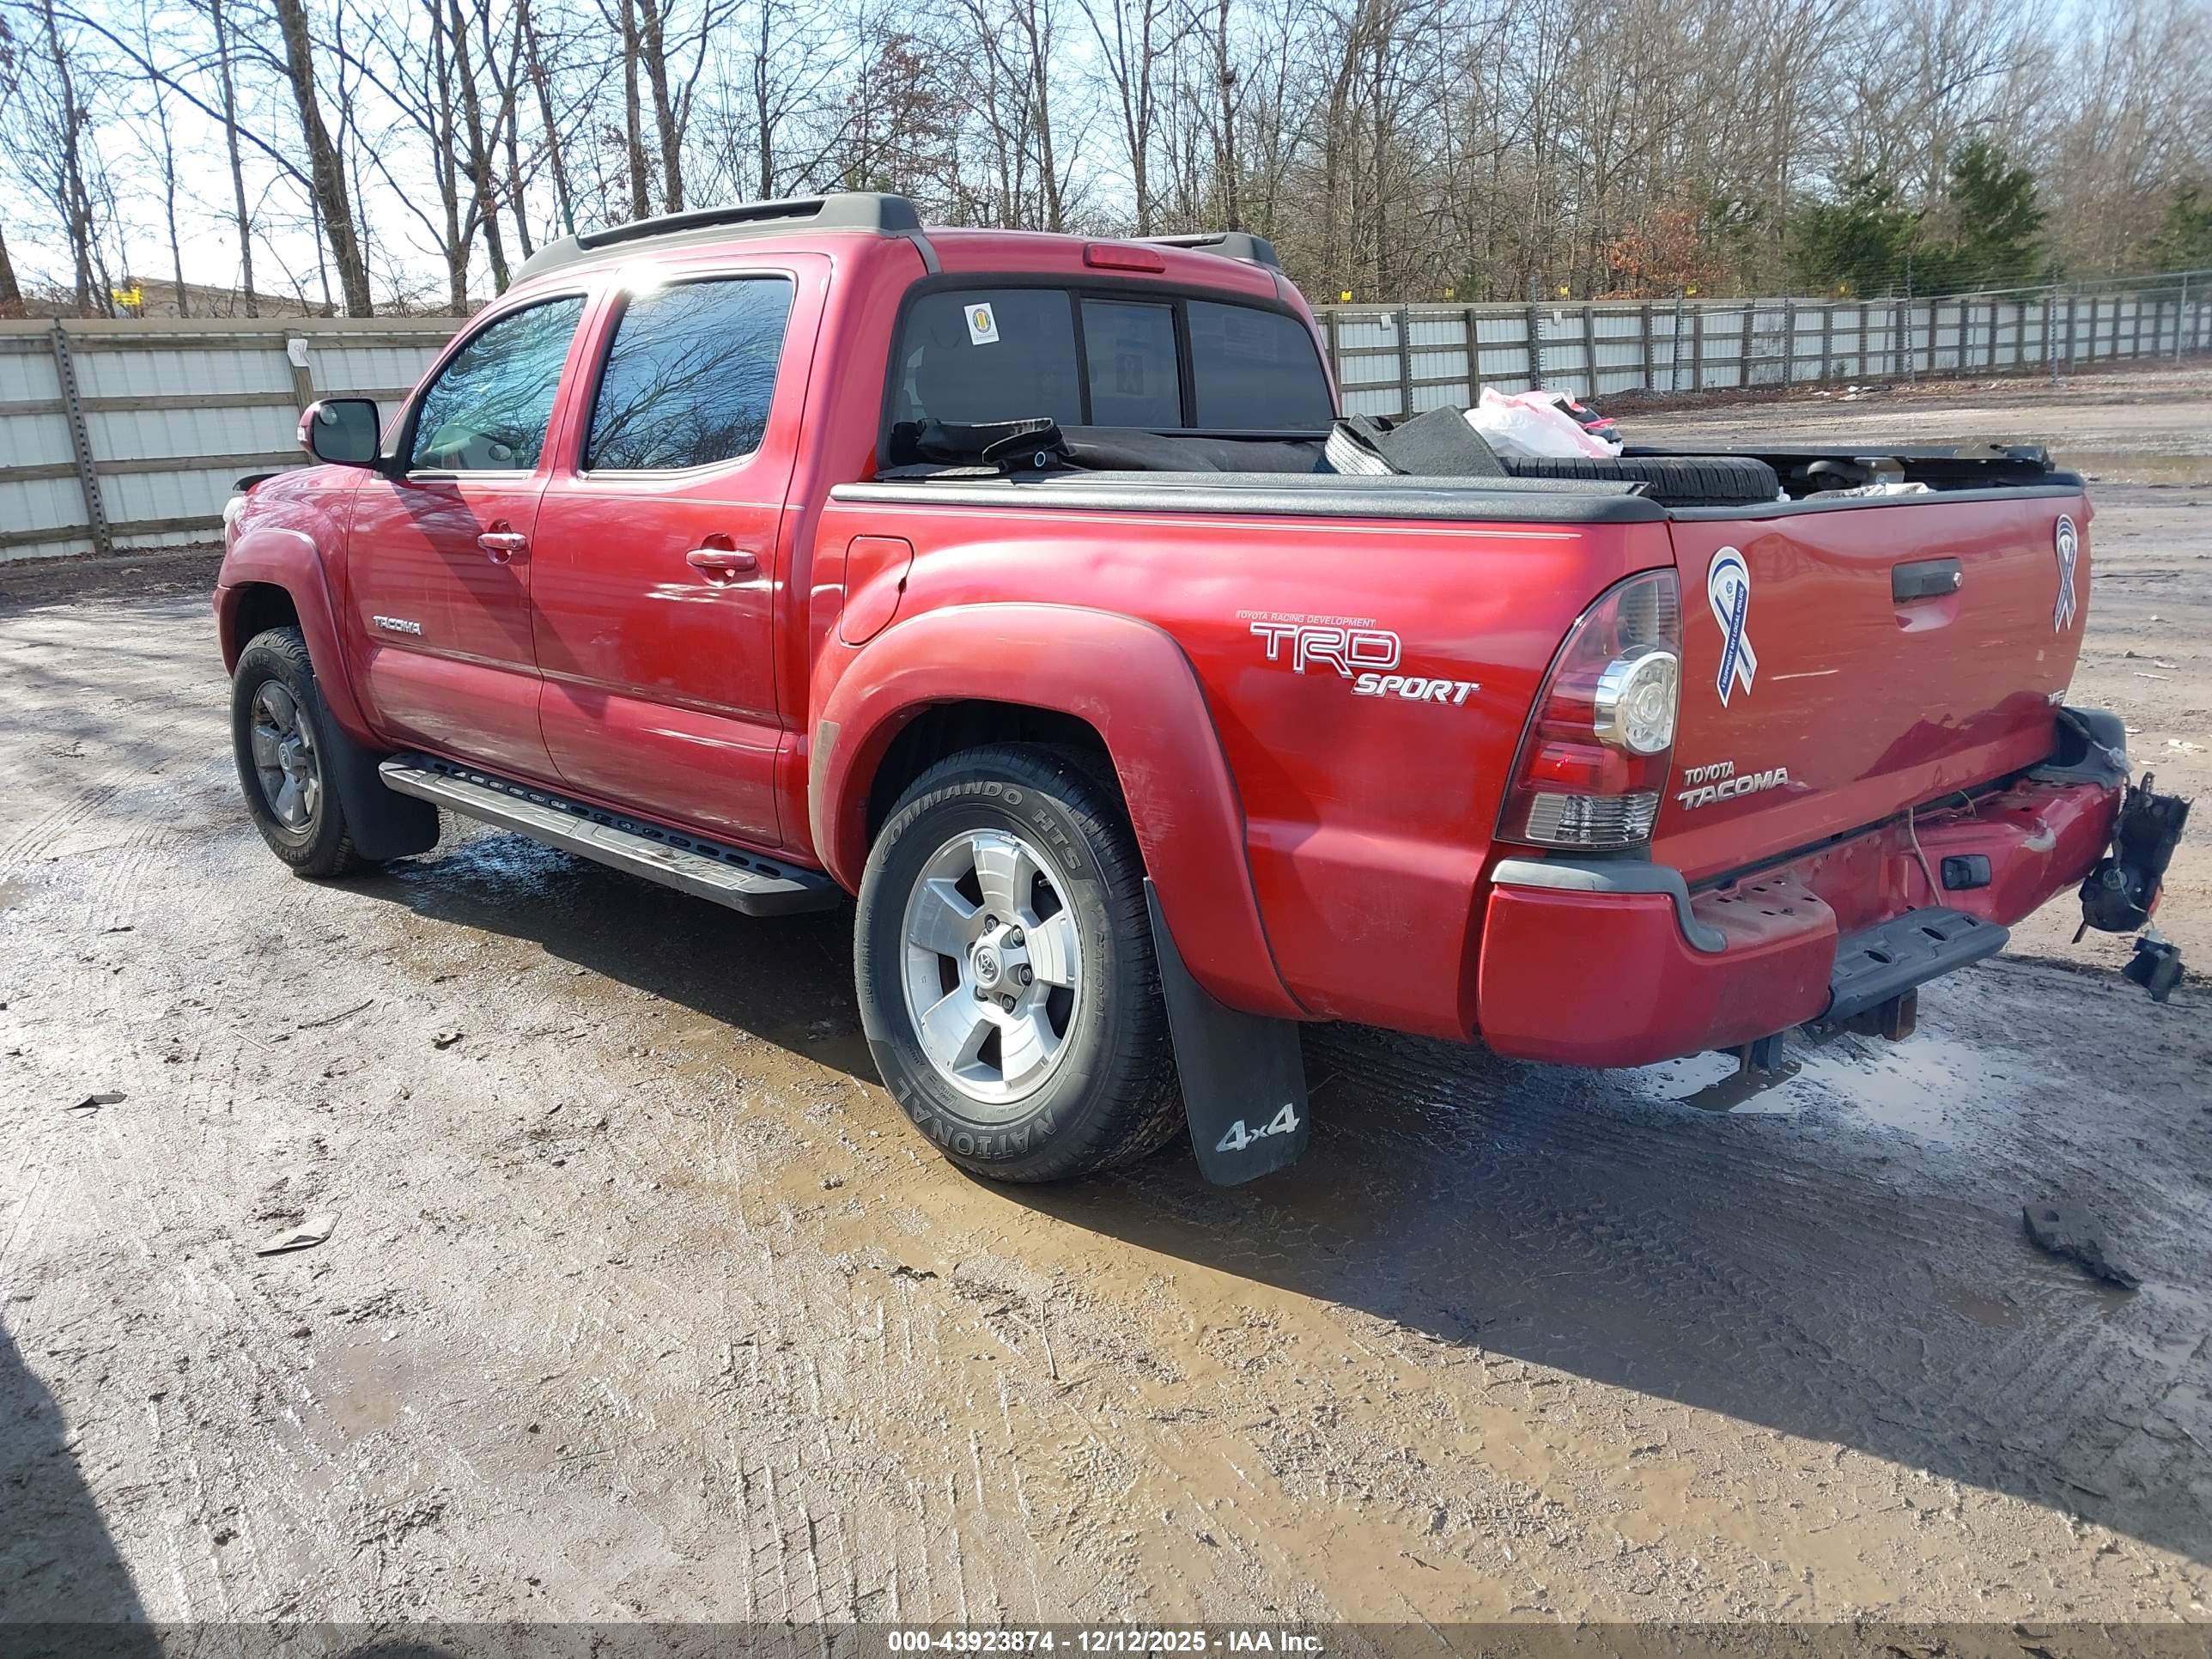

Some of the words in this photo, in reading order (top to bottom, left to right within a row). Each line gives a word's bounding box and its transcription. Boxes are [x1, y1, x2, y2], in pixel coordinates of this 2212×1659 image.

[373, 615, 422, 635] TACOMA
[1236, 610, 1267, 620] TOYOTA
[1271, 612, 1304, 623] RACING
[1307, 614, 1376, 628] DEVELOPMENT
[1250, 622, 1401, 678] TRD
[1723, 651, 1734, 684] SUPPORT
[1352, 673, 1480, 706] SPORT
[1677, 767, 1789, 811] TACOMA
[1684, 761, 1735, 787] TOYOTA
[879, 780, 1024, 866] COMMANDO
[1031, 808, 1083, 871] HTS
[896, 1077, 1056, 1161] NATIONAL
[1215, 1102, 1300, 1152] 4x4
